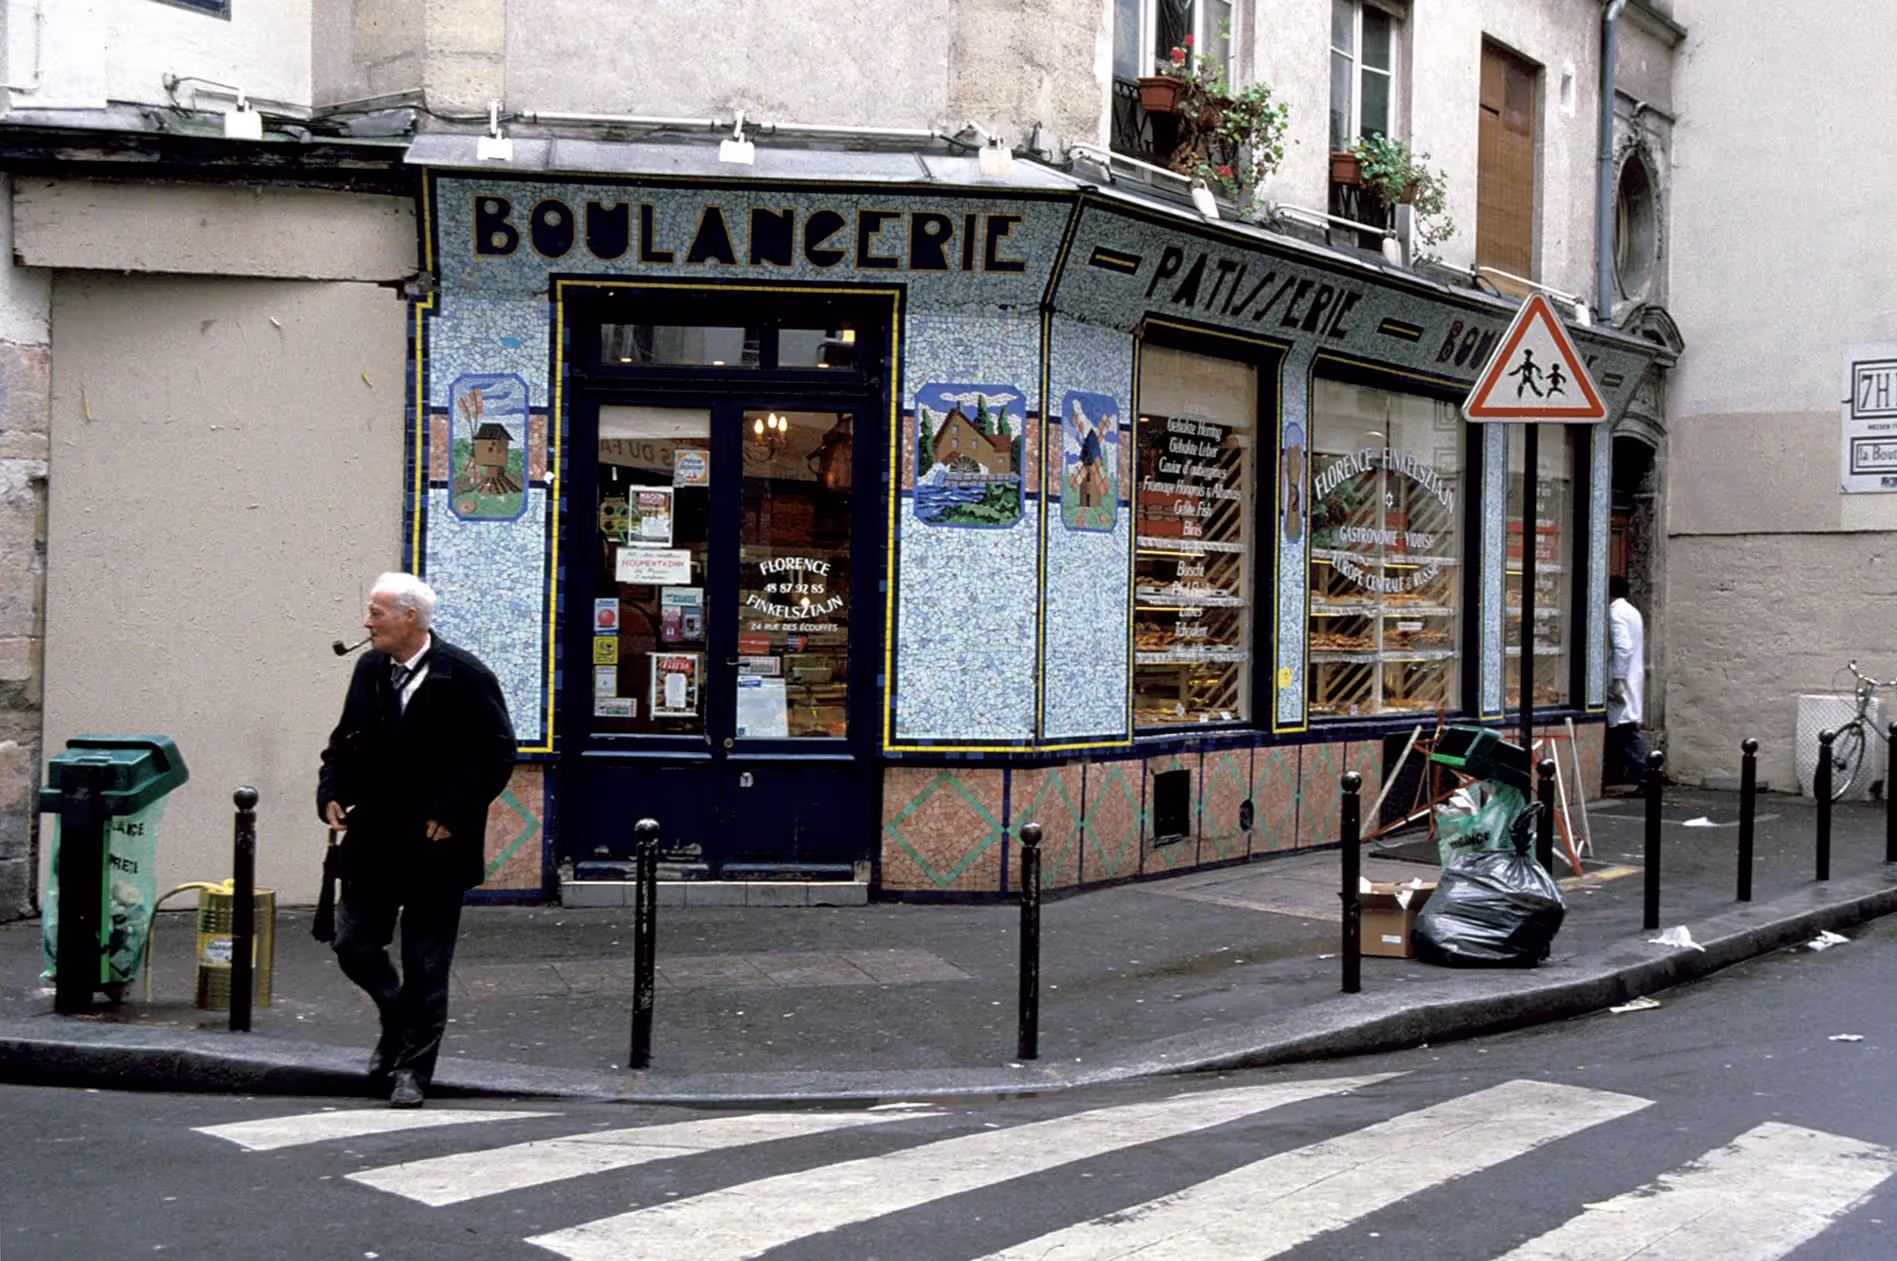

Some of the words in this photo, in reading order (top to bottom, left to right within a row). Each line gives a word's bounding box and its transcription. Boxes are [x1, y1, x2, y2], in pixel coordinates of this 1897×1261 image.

[475, 196, 1028, 273] BOULANGERIE
[1144, 244, 1362, 340] PATISSERIE
[1314, 447, 1373, 501] FLORENCE
[1340, 526, 1398, 546] GASTRONOMIE
[759, 557, 831, 576] FLORENCE
[764, 583, 777, 594] 48
[779, 583, 793, 594] 87
[795, 584, 809, 595] 92
[811, 584, 825, 594] 85
[746, 594, 844, 619] FINKELSZTAJN
[764, 622, 780, 631] RUE
[782, 622, 798, 632] DES
